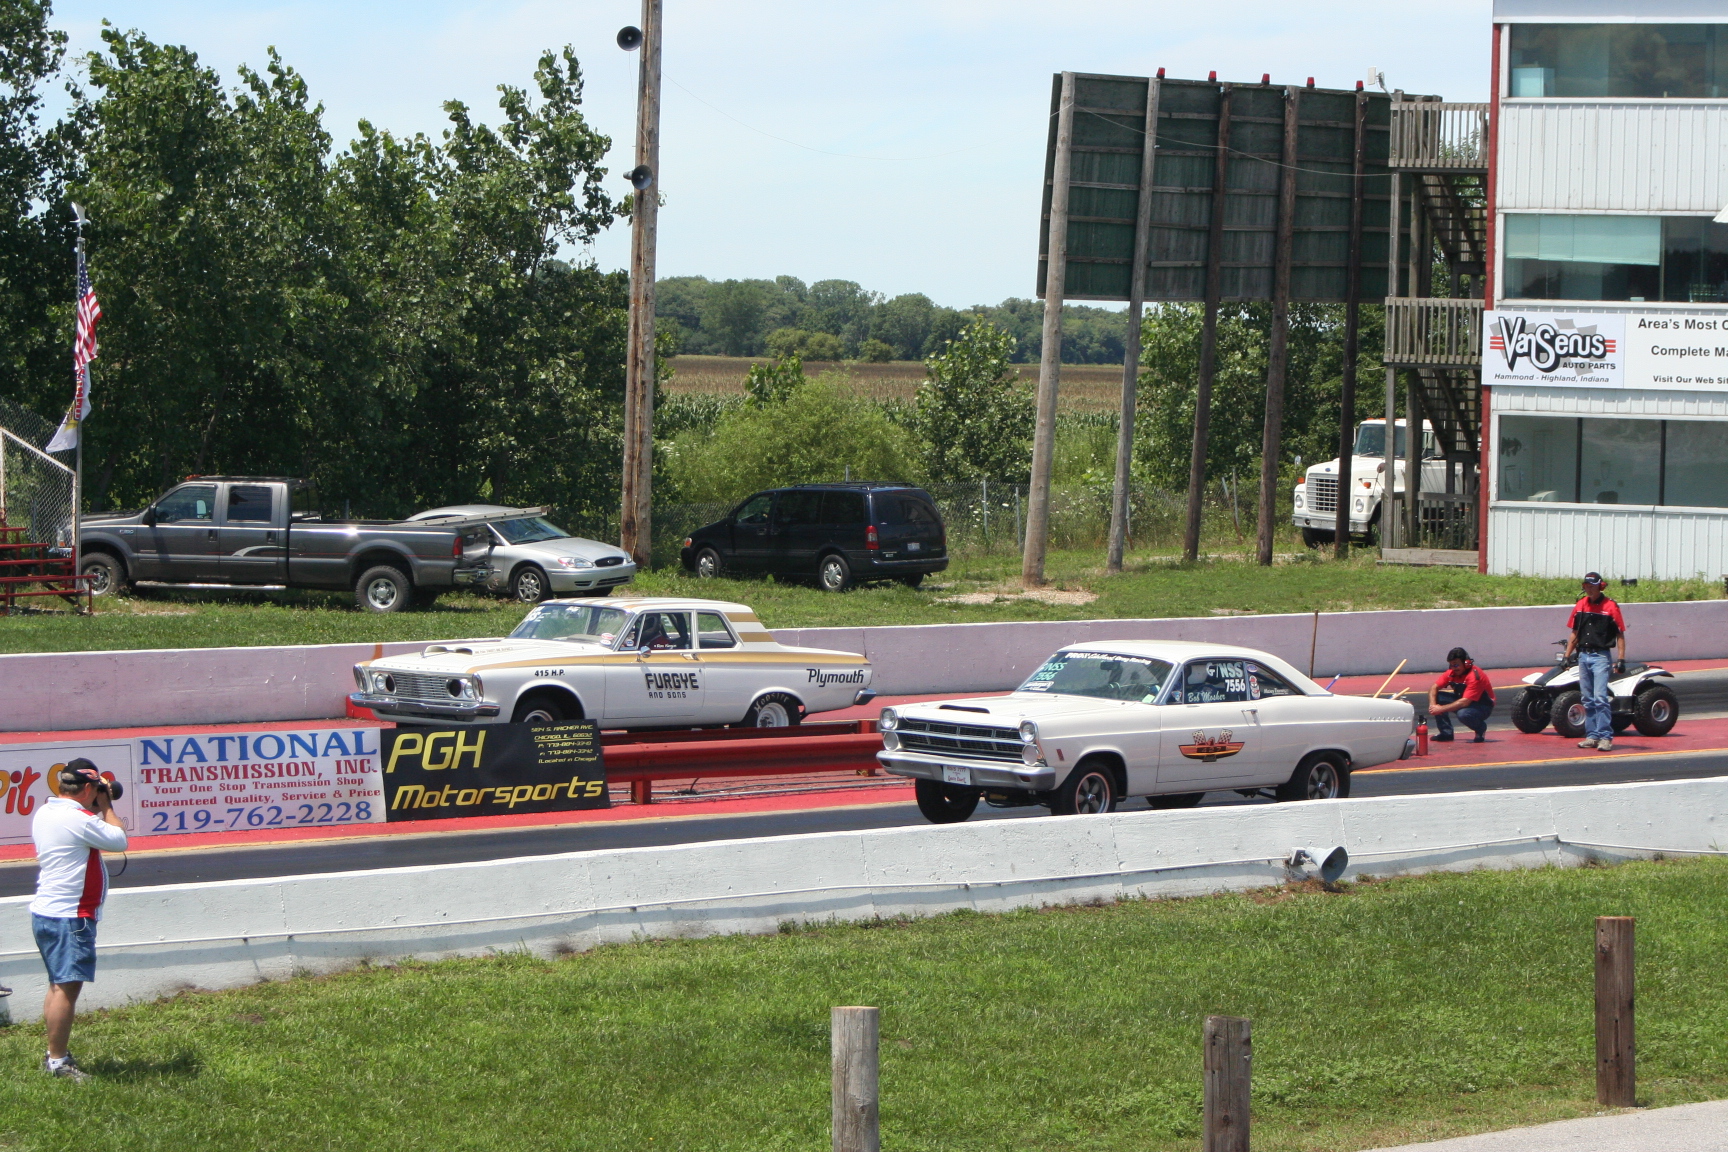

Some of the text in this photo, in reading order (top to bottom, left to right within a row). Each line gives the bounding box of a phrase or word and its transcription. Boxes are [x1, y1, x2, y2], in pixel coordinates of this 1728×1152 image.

[1637, 318, 1680, 331] Area's
[1684, 318, 1718, 331] Most
[1651, 344, 1712, 358] Complete
[1588, 362, 1616, 370] PARTS
[1494, 373, 1534, 381] Hammond
[1541, 374, 1578, 383] Highland,
[1580, 375, 1609, 383] Indiana
[1653, 375, 1674, 384] Visit
[1675, 375, 1693, 384] Our
[1695, 376, 1715, 384] Web
[534, 669, 550, 677] 415
[806, 668, 865, 688] Plymouth
[1206, 662, 1244, 678] G/NSS
[645, 673, 699, 690] FURGYE
[1224, 679, 1246, 693] 7556
[648, 691, 687, 699] AND SONS
[1187, 690, 1226, 703] Bob Mosher
[140, 730, 378, 765] NATIONAL
[385, 730, 487, 774] PGH
[141, 758, 378, 784] TRANSMISSION, INC.
[153, 776, 364, 794] Your One Stop Transmission Shop
[391, 775, 604, 811] Motorsports
[141, 788, 381, 808] Guaranteed Quality, Service & Price
[151, 800, 372, 832] 219-762-2228
